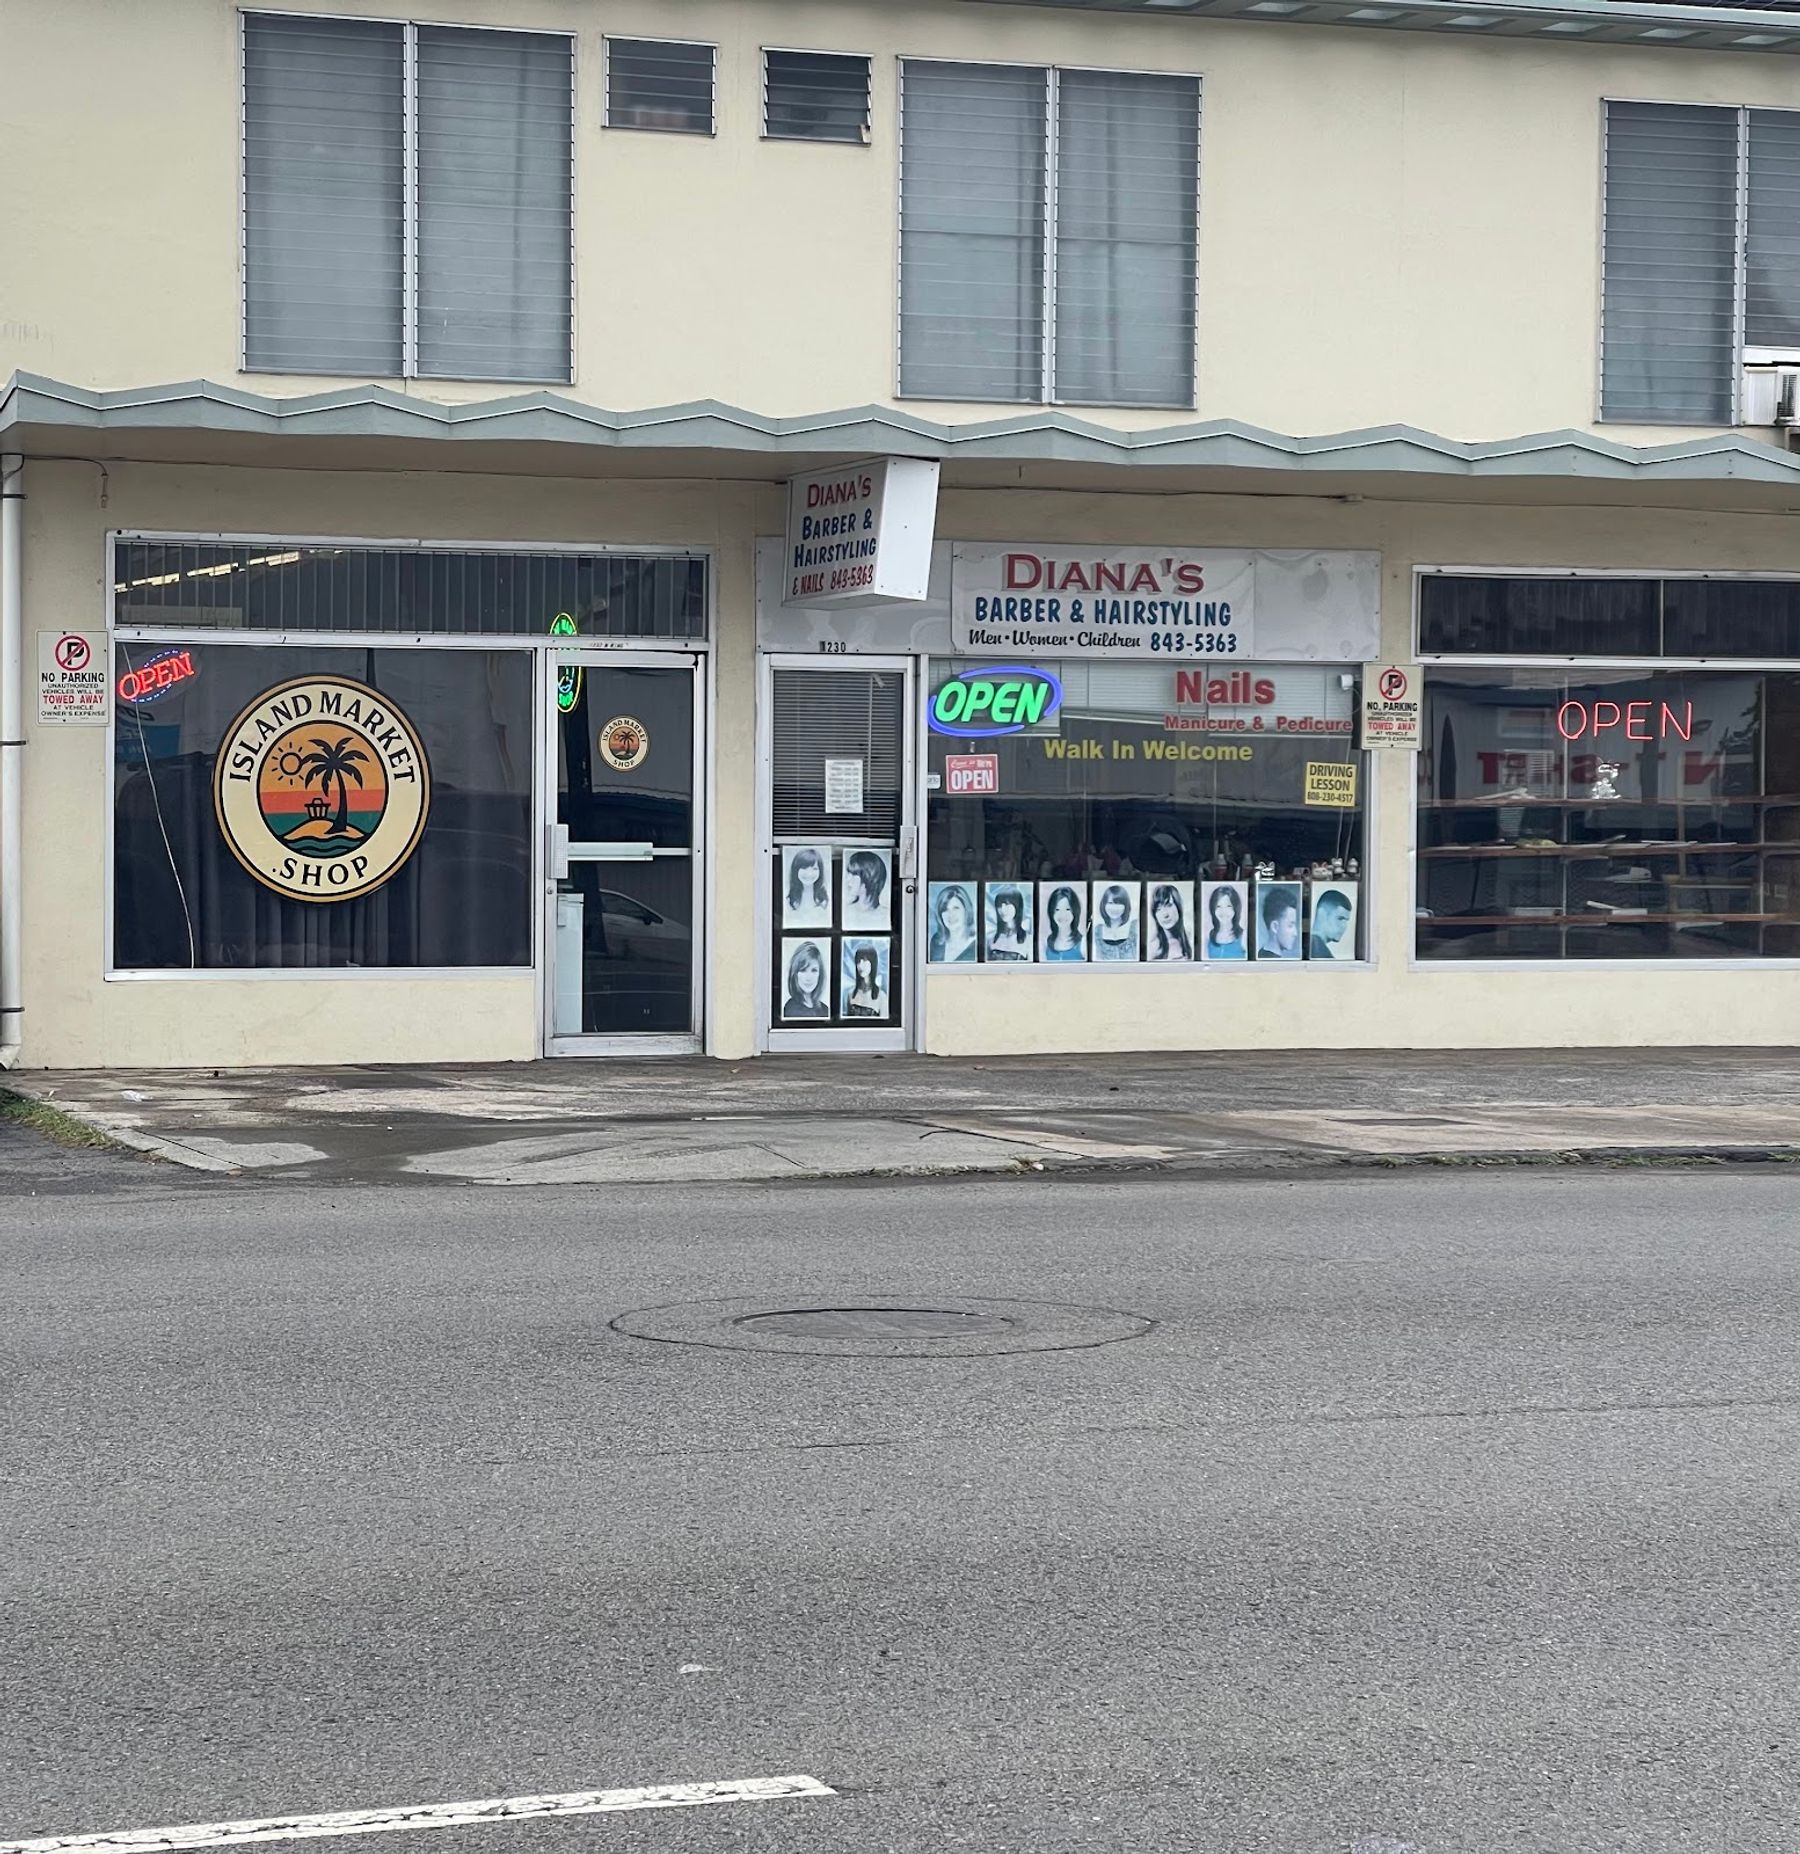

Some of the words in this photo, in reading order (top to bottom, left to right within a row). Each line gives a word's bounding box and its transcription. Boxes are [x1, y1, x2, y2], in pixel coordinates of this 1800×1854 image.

[807, 475, 872, 508] DIANA'S
[802, 513, 856, 540] BARBER
[863, 508, 872, 529] &
[794, 538, 877, 568] HAIRSTYLING
[792, 577, 799, 595] &
[801, 572, 824, 595] NAILS
[830, 564, 874, 590] 843-5363
[1003, 553, 1205, 594] DIANA'S
[975, 597, 1061, 623] BARBER
[1070, 599, 1085, 623] &
[1094, 599, 1232, 627] HAIRSTYLING
[819, 641, 846, 653] 1230
[1150, 632, 1238, 653] 843-5363
[41, 672, 56, 682] NO
[61, 672, 105, 683] PARKING
[118, 651, 195, 701] OPEN
[43, 695, 74, 704] TOWED
[80, 695, 104, 704] AWAY
[1176, 671, 1276, 705] Nails
[935, 681, 1049, 723] OPEN
[1383, 702, 1418, 712] PARKING
[603, 719, 623, 741] ISLAND
[624, 719, 647, 743] MARKET
[1165, 715, 1246, 731] Manicure
[1252, 715, 1264, 731] &
[1276, 716, 1353, 732] Pedicure
[1368, 722, 1394, 730] TOWED
[1397, 722, 1416, 730] AWAY
[1558, 701, 1692, 741] OPEN
[229, 694, 312, 783] ISLAND
[319, 690, 416, 784] MARKET
[1044, 739, 1104, 759] Walk
[1113, 740, 1135, 760] In
[1143, 740, 1253, 761] Welcome
[614, 760, 635, 768] SHOP
[1309, 764, 1353, 778] DRIVING
[951, 769, 994, 790] OPEN
[1311, 779, 1350, 791] LESSON
